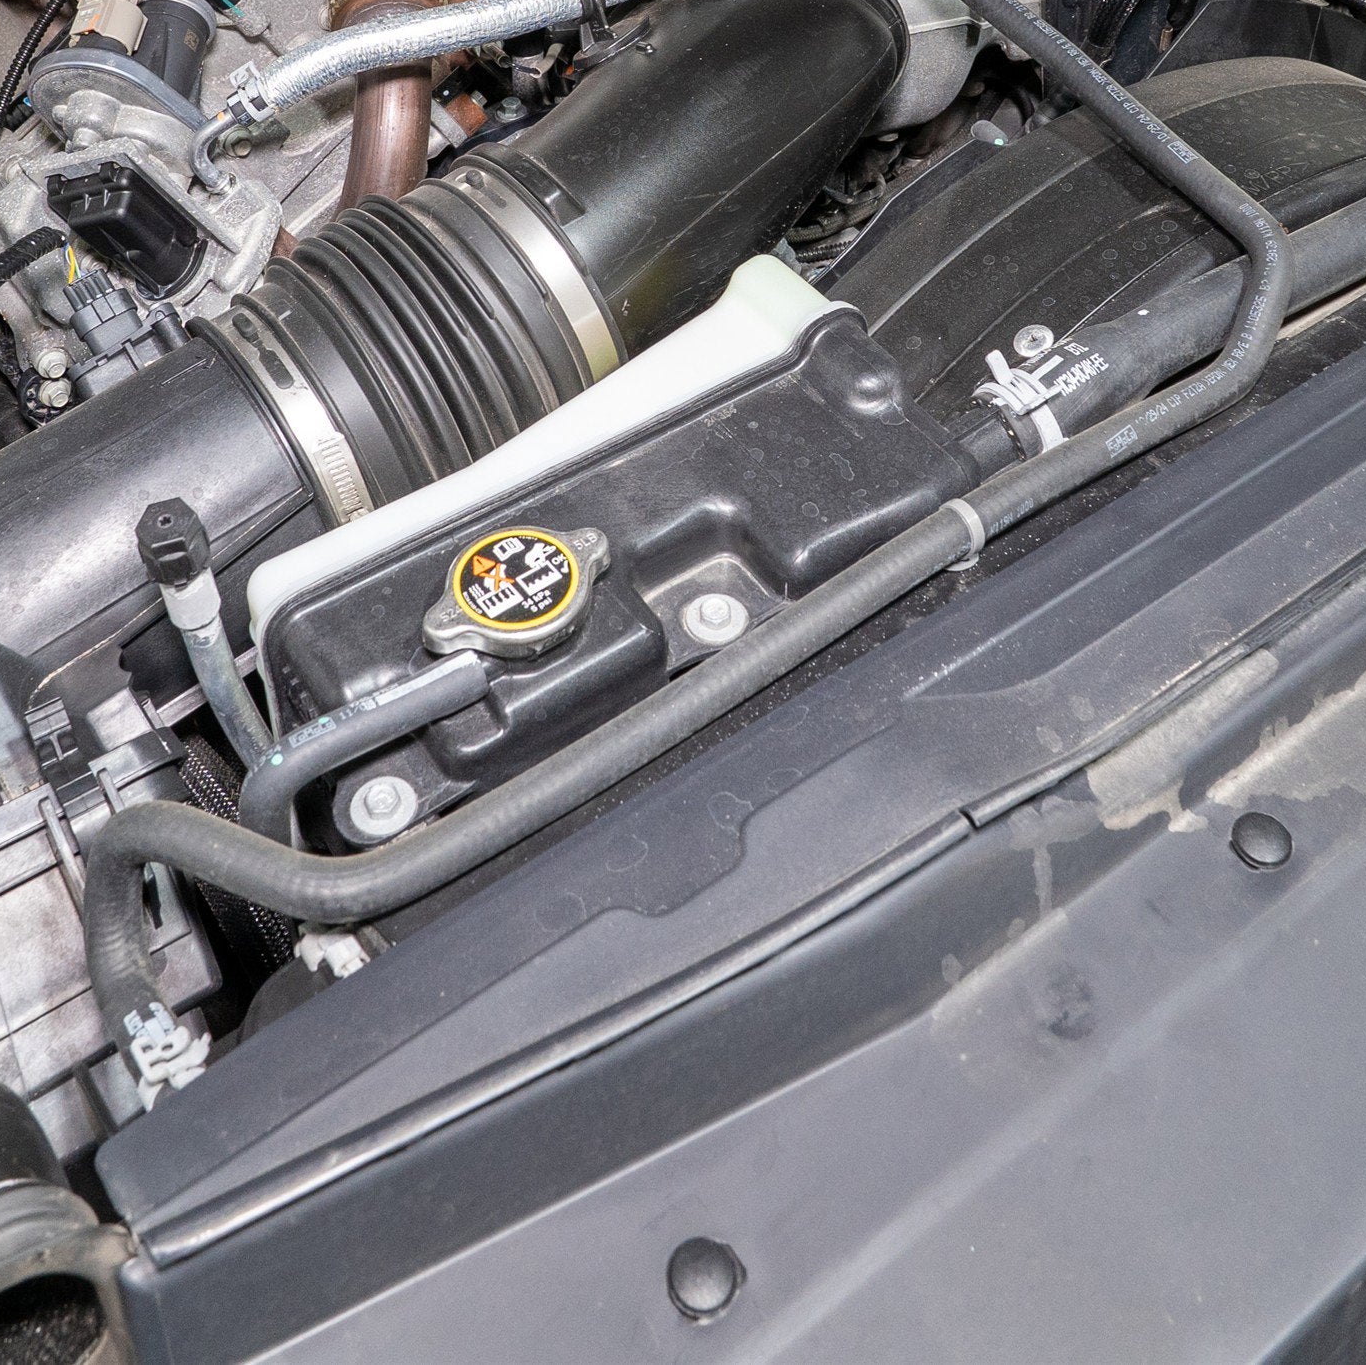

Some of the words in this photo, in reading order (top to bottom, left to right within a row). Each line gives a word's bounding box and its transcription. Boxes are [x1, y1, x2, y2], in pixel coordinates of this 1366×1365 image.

[1136, 114, 1169, 142] 10/29/24
[1167, 394, 1181, 407] CIP
[572, 532, 598, 550] 5LB
[551, 554, 566, 564] OK
[521, 598, 533, 608] 34
[533, 589, 551, 601] kPa
[538, 597, 552, 609] psi
